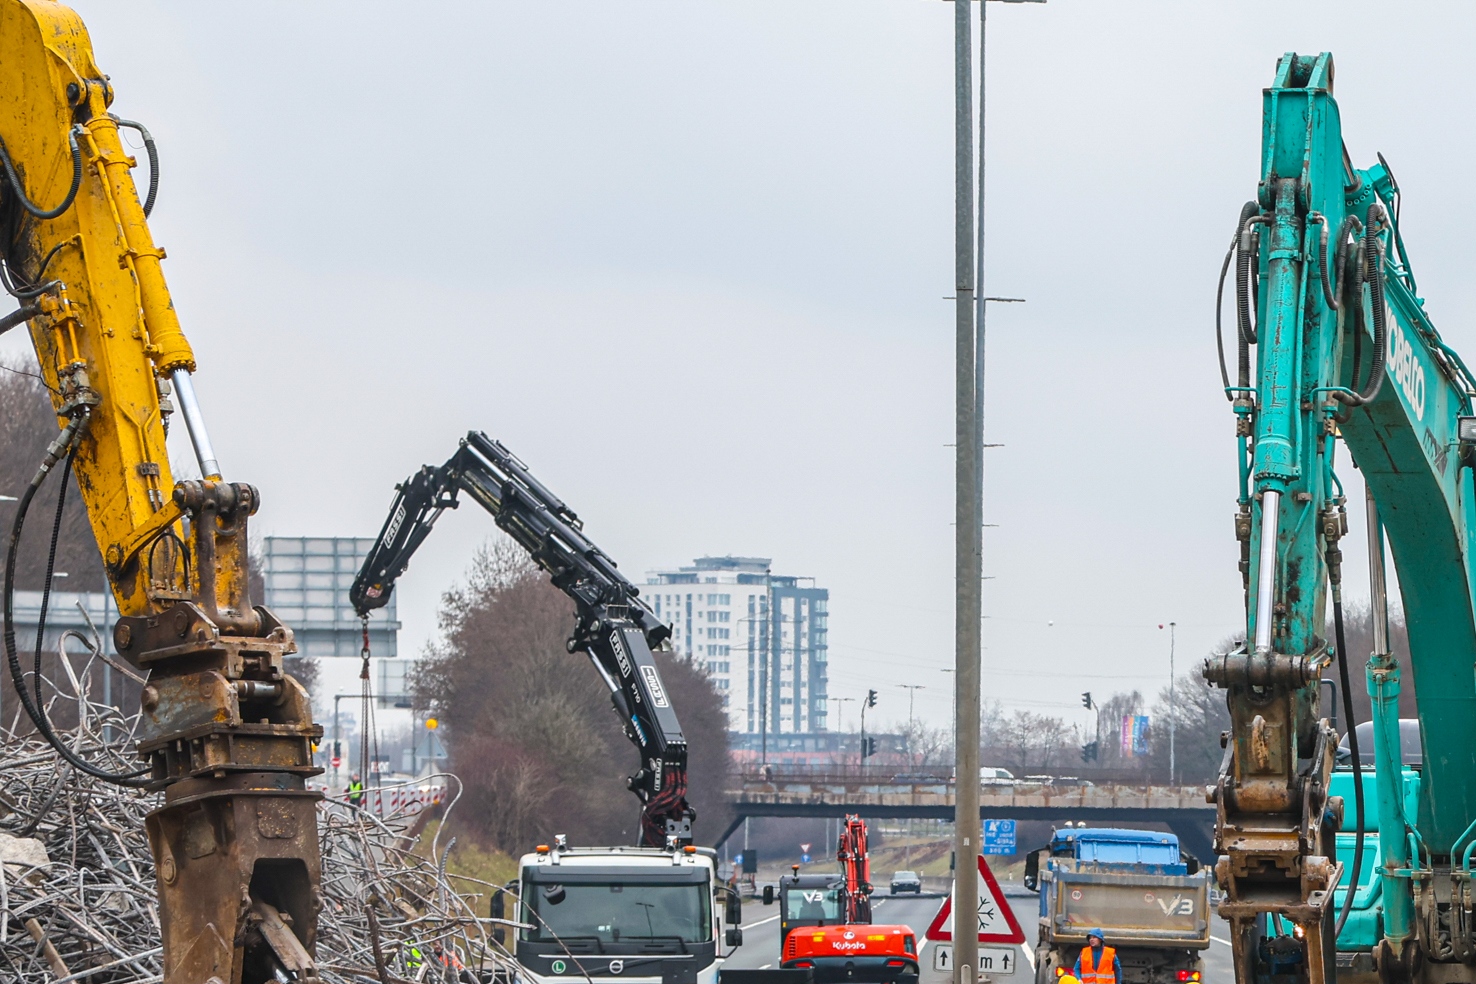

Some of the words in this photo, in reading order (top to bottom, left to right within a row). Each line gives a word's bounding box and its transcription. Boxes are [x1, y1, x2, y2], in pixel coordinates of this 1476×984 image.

[610, 632, 630, 676] FASSI
[803, 890, 824, 904] V3
[1157, 893, 1194, 917] V3
[833, 941, 866, 950] Kubota
